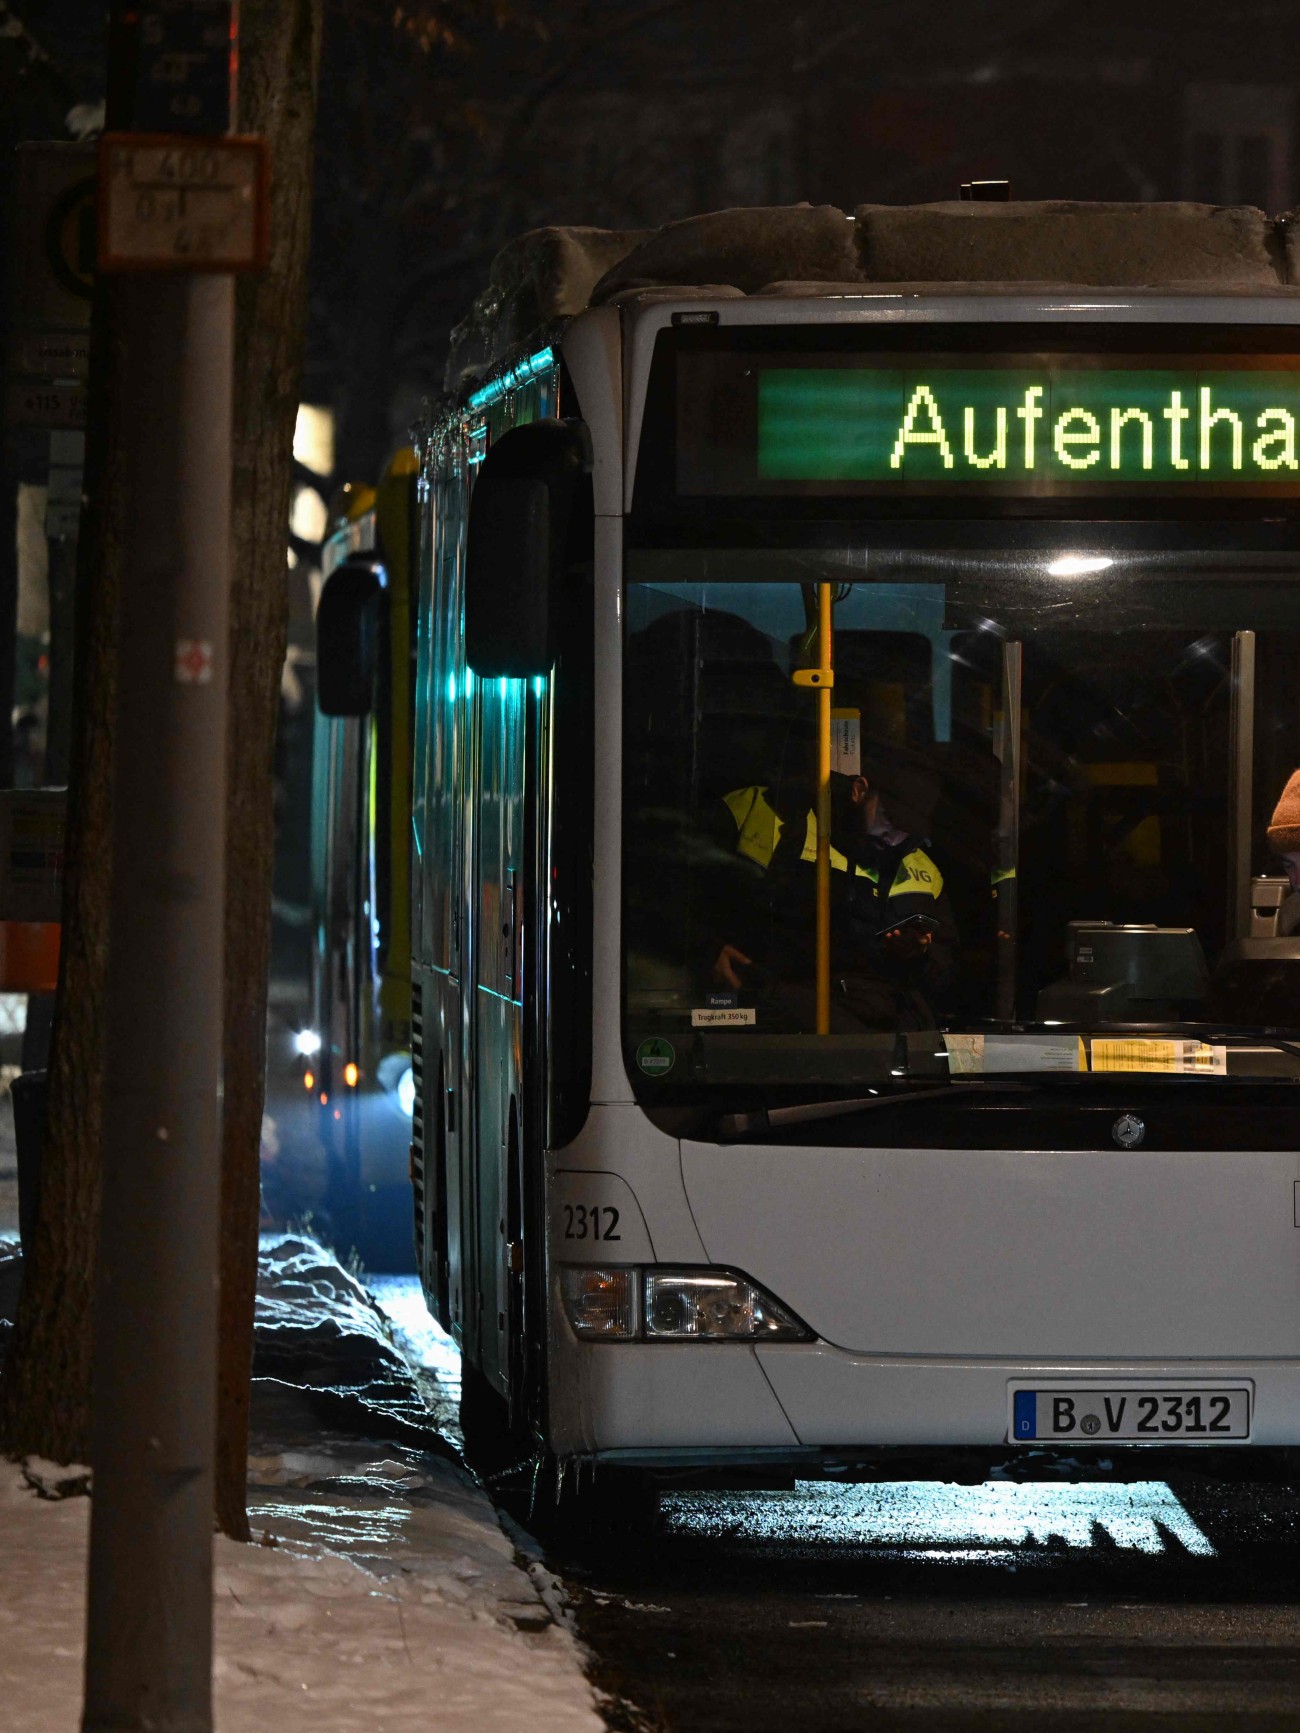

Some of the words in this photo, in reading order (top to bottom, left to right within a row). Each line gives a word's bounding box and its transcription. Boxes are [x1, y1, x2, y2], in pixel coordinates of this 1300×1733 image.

[36, 395, 61, 411] 115
[905, 866, 932, 883] VG
[710, 997, 732, 1006] Rampe
[698, 1013, 726, 1022] Tragkraft
[740, 1012, 748, 1021] kg
[650, 1040, 661, 1056] 4
[564, 1204, 621, 1241] 2312
[1053, 1397, 1076, 1433] B
[1104, 1396, 1127, 1432] V
[1137, 1396, 1231, 1432] 2312
[1021, 1420, 1030, 1431] D
